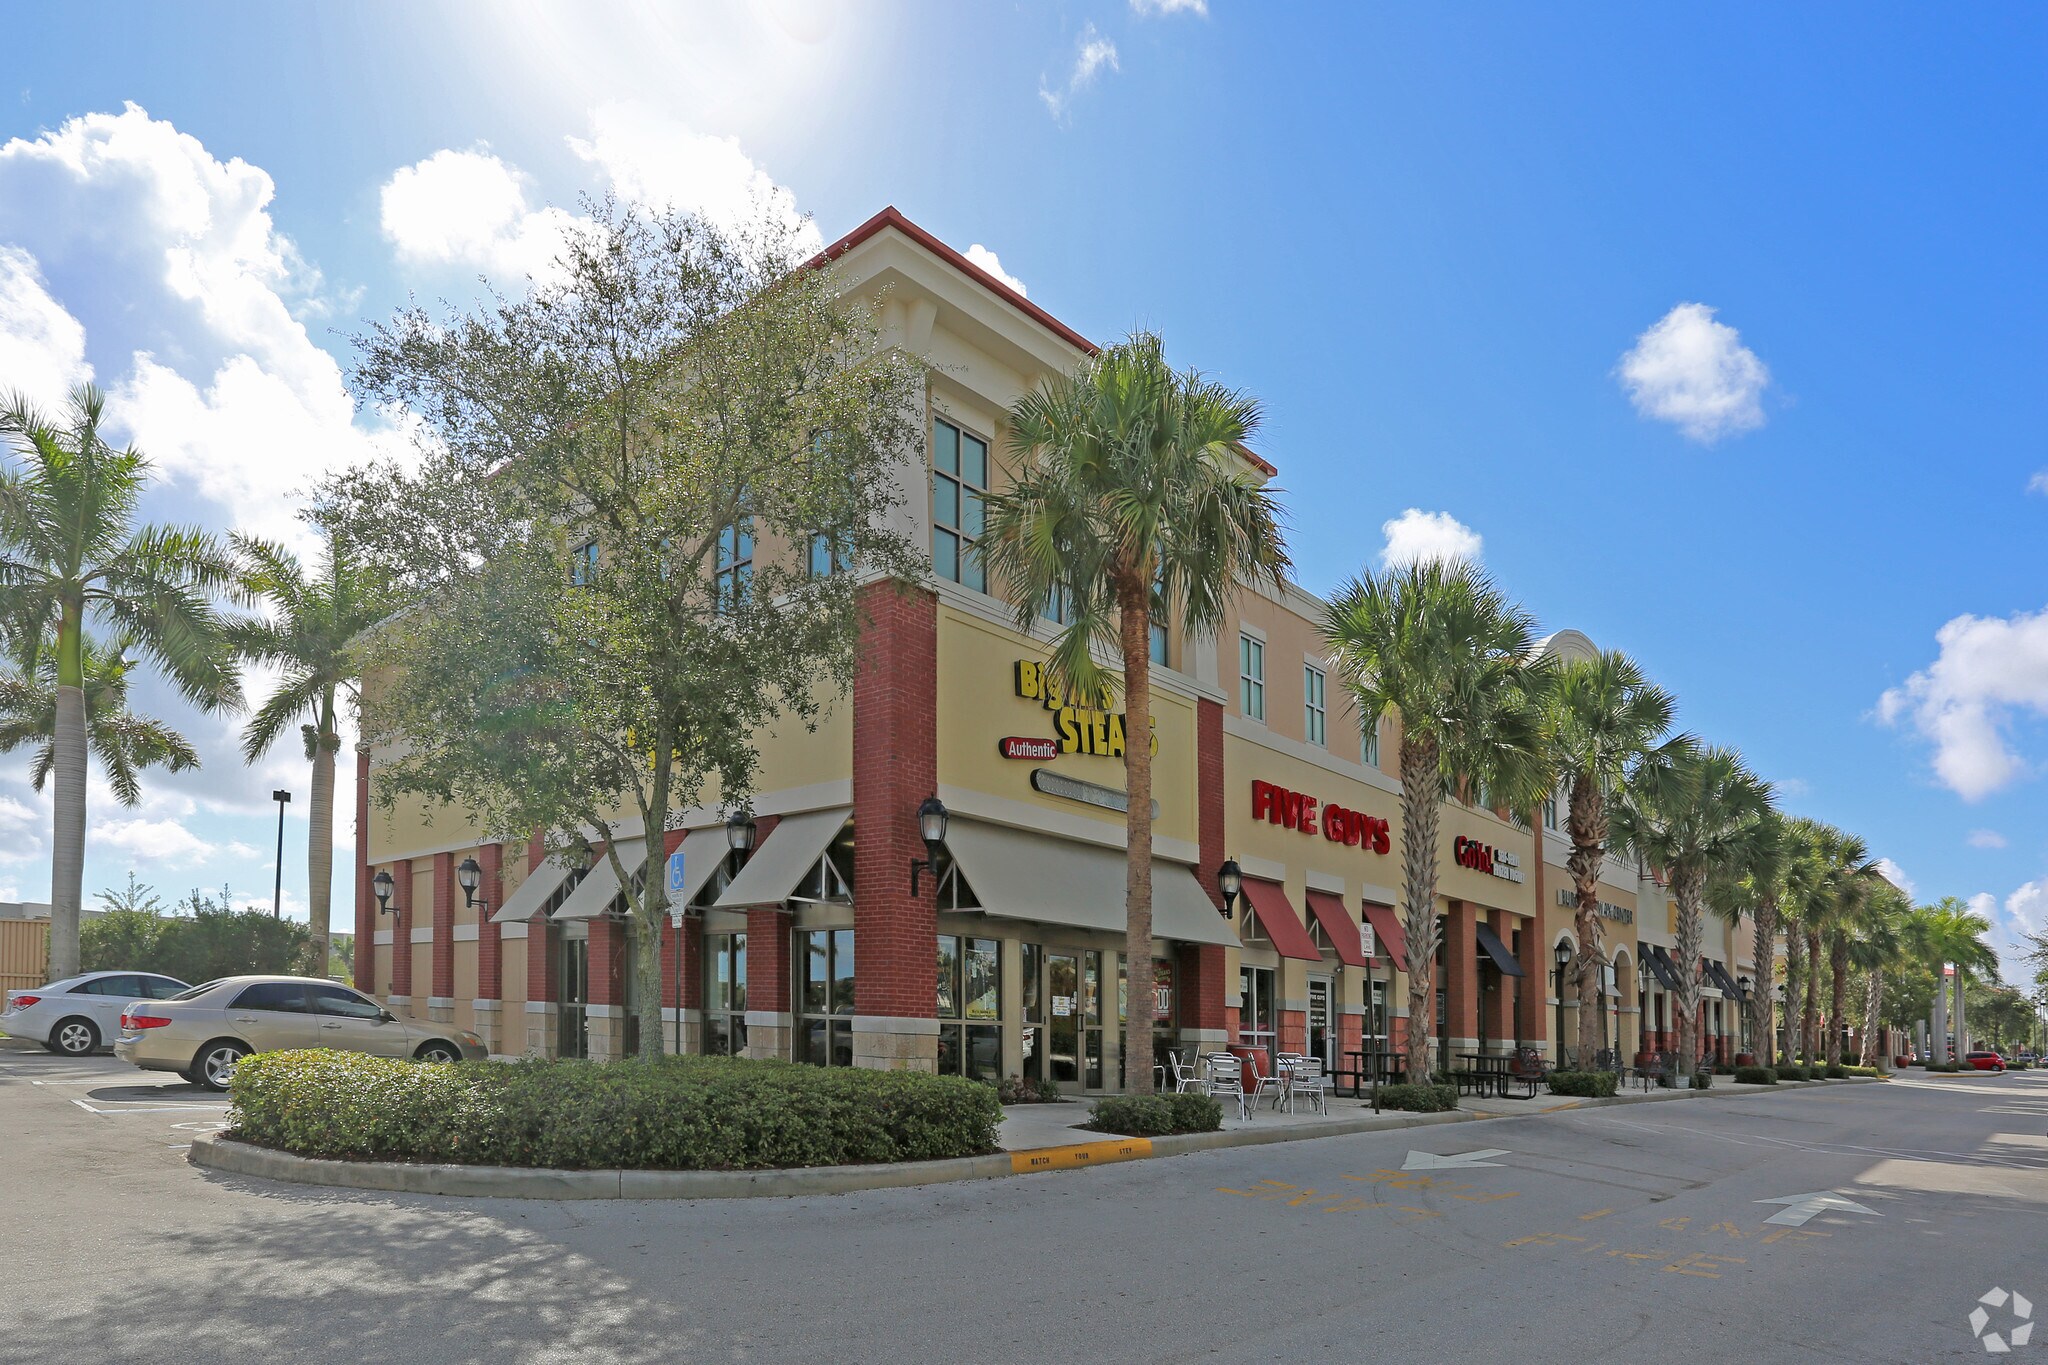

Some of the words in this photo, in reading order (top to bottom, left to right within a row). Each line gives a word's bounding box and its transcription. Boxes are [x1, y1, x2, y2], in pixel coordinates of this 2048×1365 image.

[1008, 741, 1056, 758] Authentic
[1252, 780, 1318, 835] FIVE
[1322, 803, 1390, 855] GUYS
[1030, 1157, 1050, 1166] WATCH
